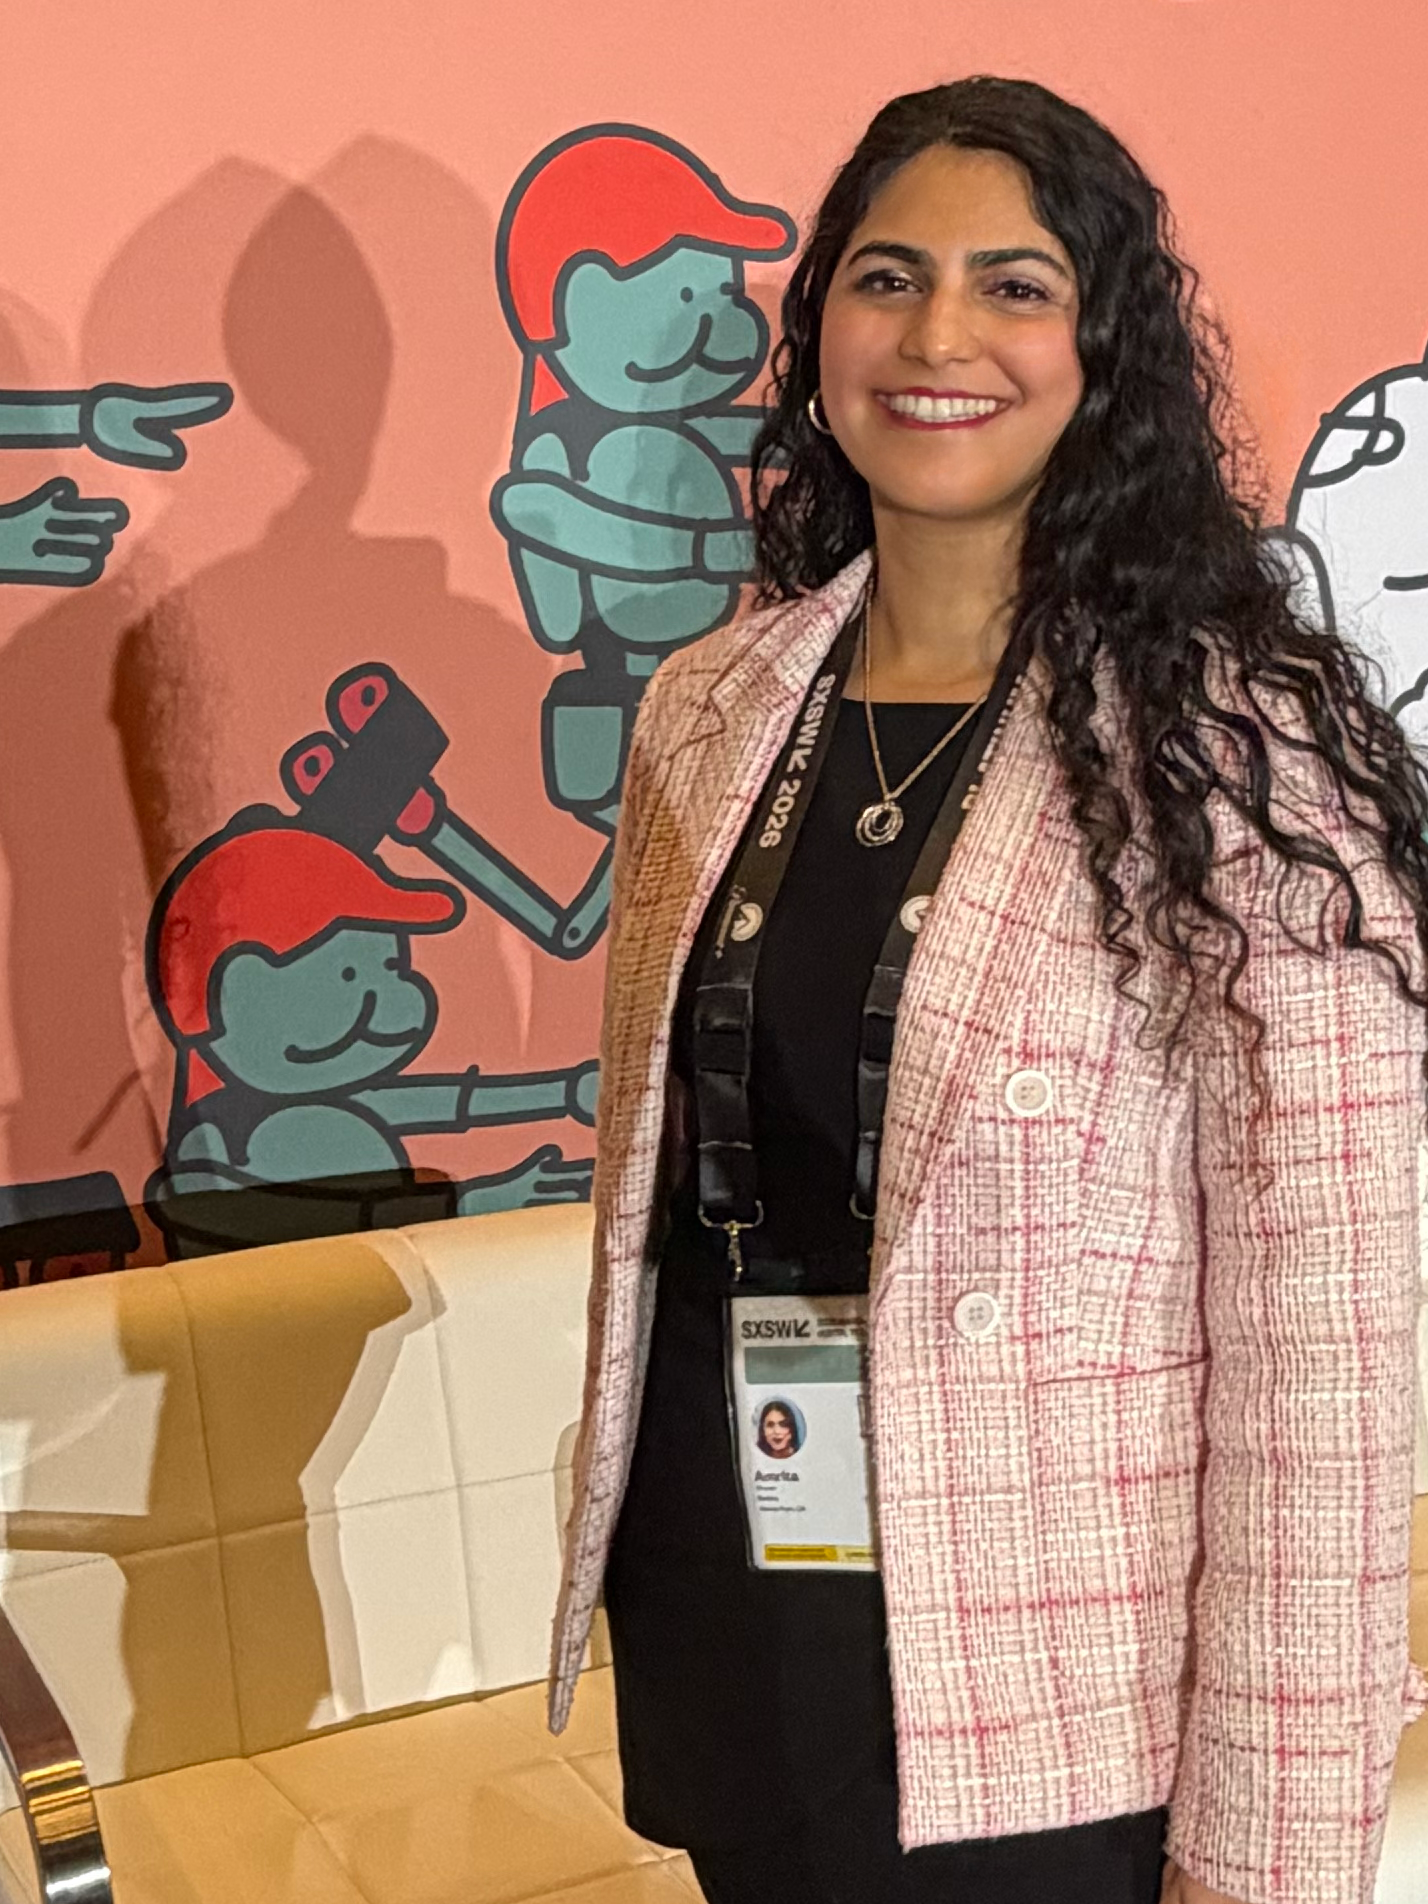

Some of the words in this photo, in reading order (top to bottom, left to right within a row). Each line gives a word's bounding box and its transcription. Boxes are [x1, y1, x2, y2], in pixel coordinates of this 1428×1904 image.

[794, 673, 836, 746] SXSW
[758, 778, 802, 850] 2026
[740, 1319, 792, 1340] SXSW
